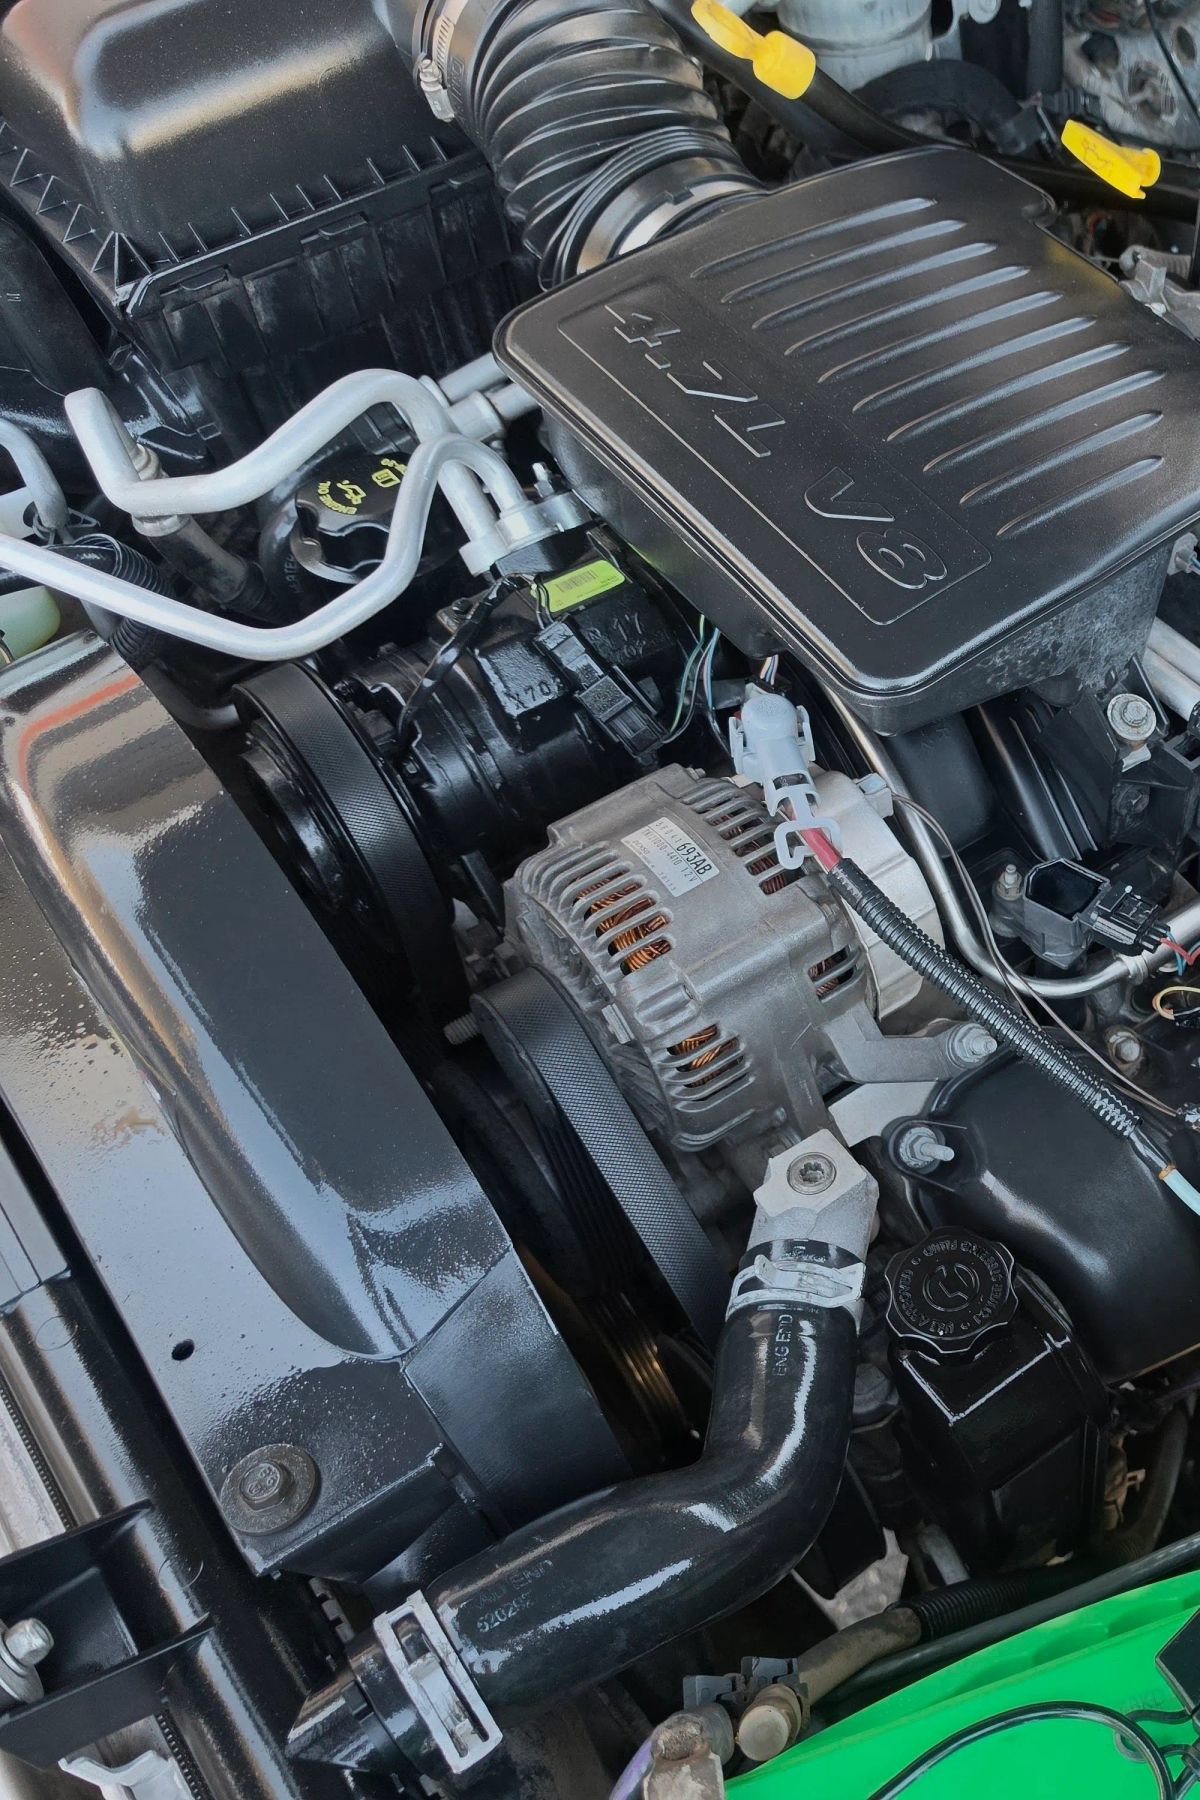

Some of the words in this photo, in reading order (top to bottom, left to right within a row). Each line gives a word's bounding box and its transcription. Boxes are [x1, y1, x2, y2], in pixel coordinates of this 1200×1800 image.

[604, 304, 788, 458] 4.7L
[804, 466, 947, 590] V8
[317, 480, 331, 494] OIL
[319, 493, 358, 515] ENGINE
[676, 842, 713, 875] 693AB
[773, 1346, 790, 1376] ENG
